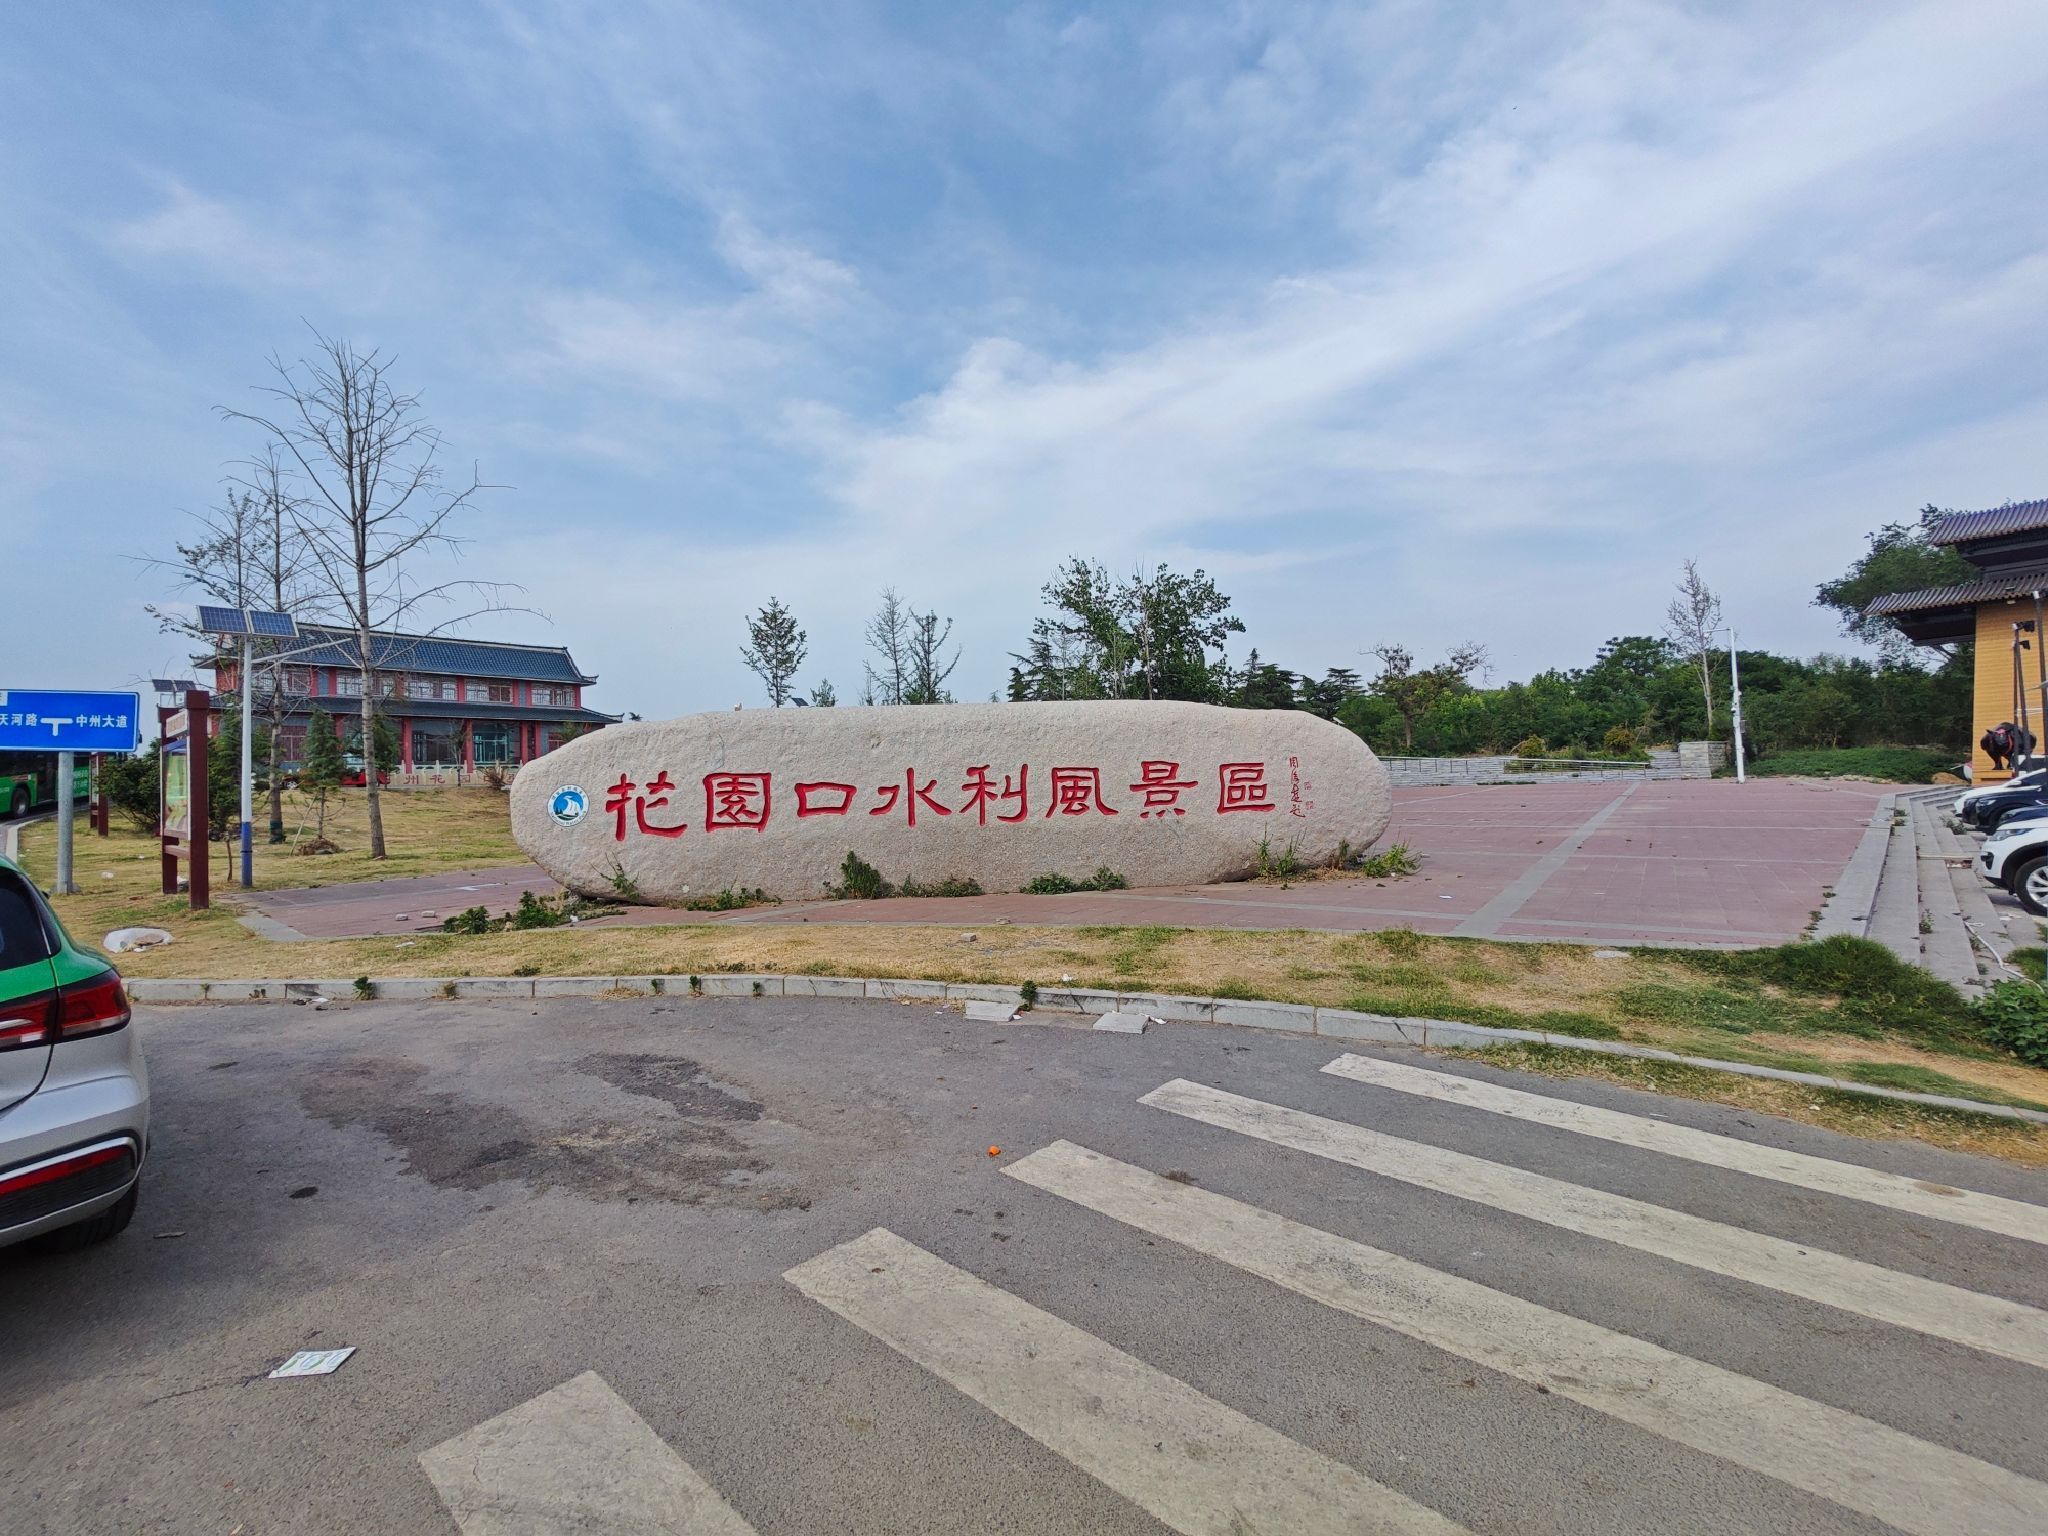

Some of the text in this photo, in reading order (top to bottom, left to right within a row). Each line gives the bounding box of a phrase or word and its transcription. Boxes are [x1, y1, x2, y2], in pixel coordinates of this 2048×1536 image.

[0, 713, 38, 727] 天河路
[76, 714, 128, 728] 中州大道
[605, 761, 1276, 841] 花園口水利風景區
